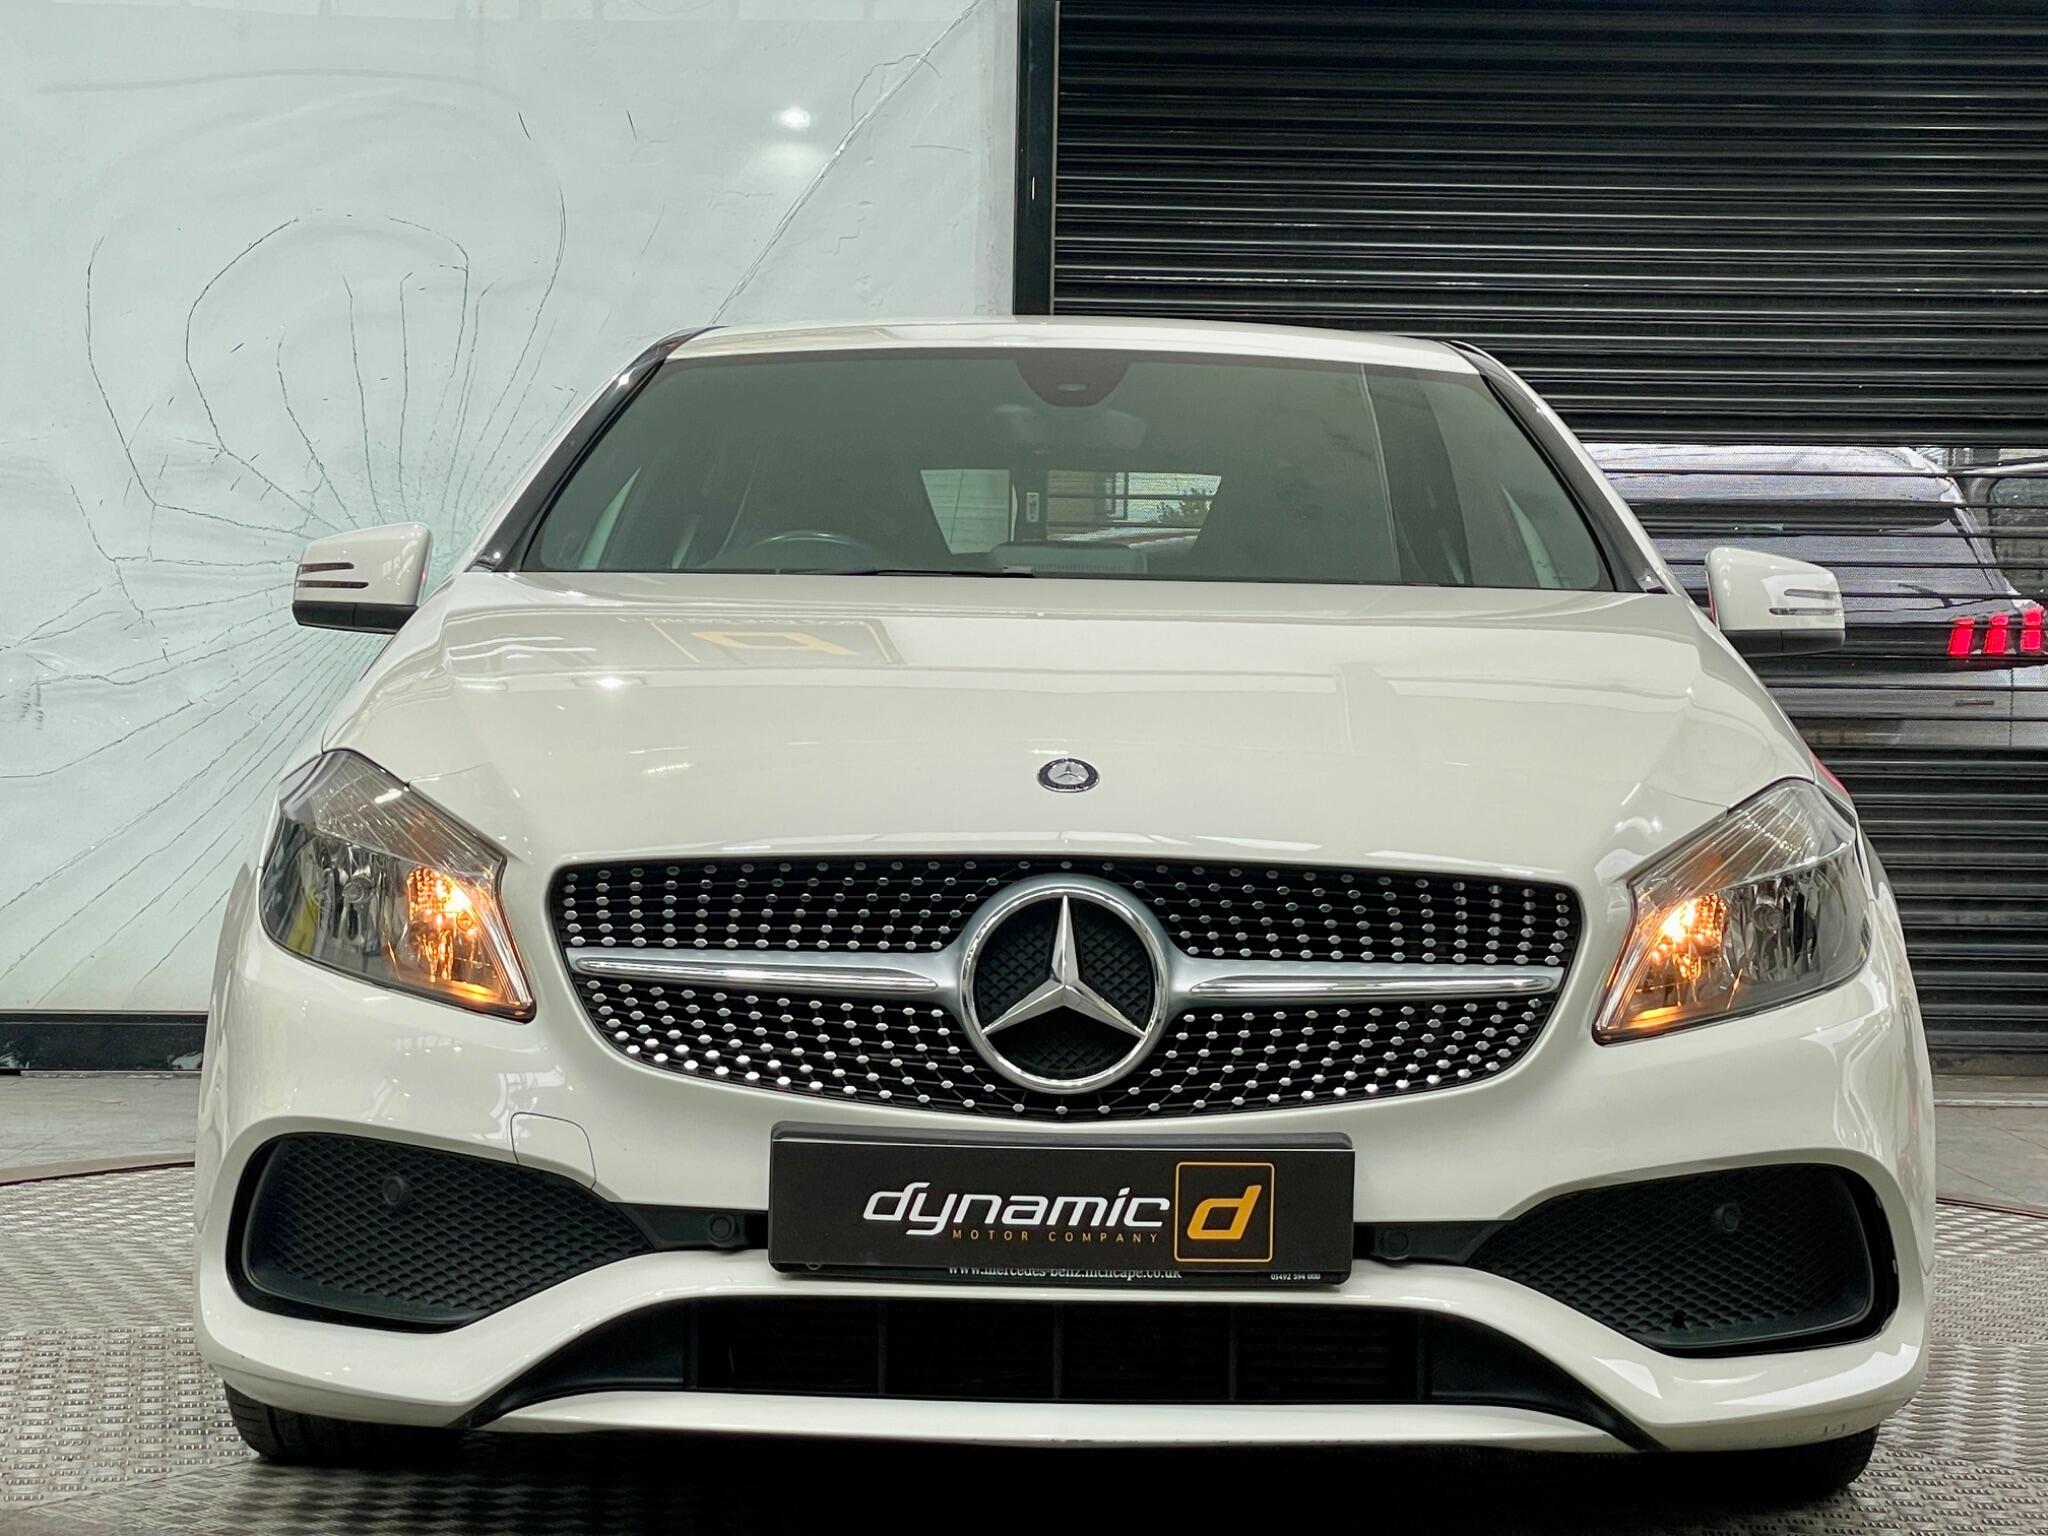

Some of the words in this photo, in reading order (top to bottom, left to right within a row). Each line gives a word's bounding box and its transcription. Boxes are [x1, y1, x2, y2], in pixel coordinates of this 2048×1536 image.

[863, 1182, 1170, 1236] dynamic
[952, 1229, 1029, 1241] MOTOR
[1048, 1231, 1159, 1243] COMPANY
[1187, 1184, 1262, 1239] d
